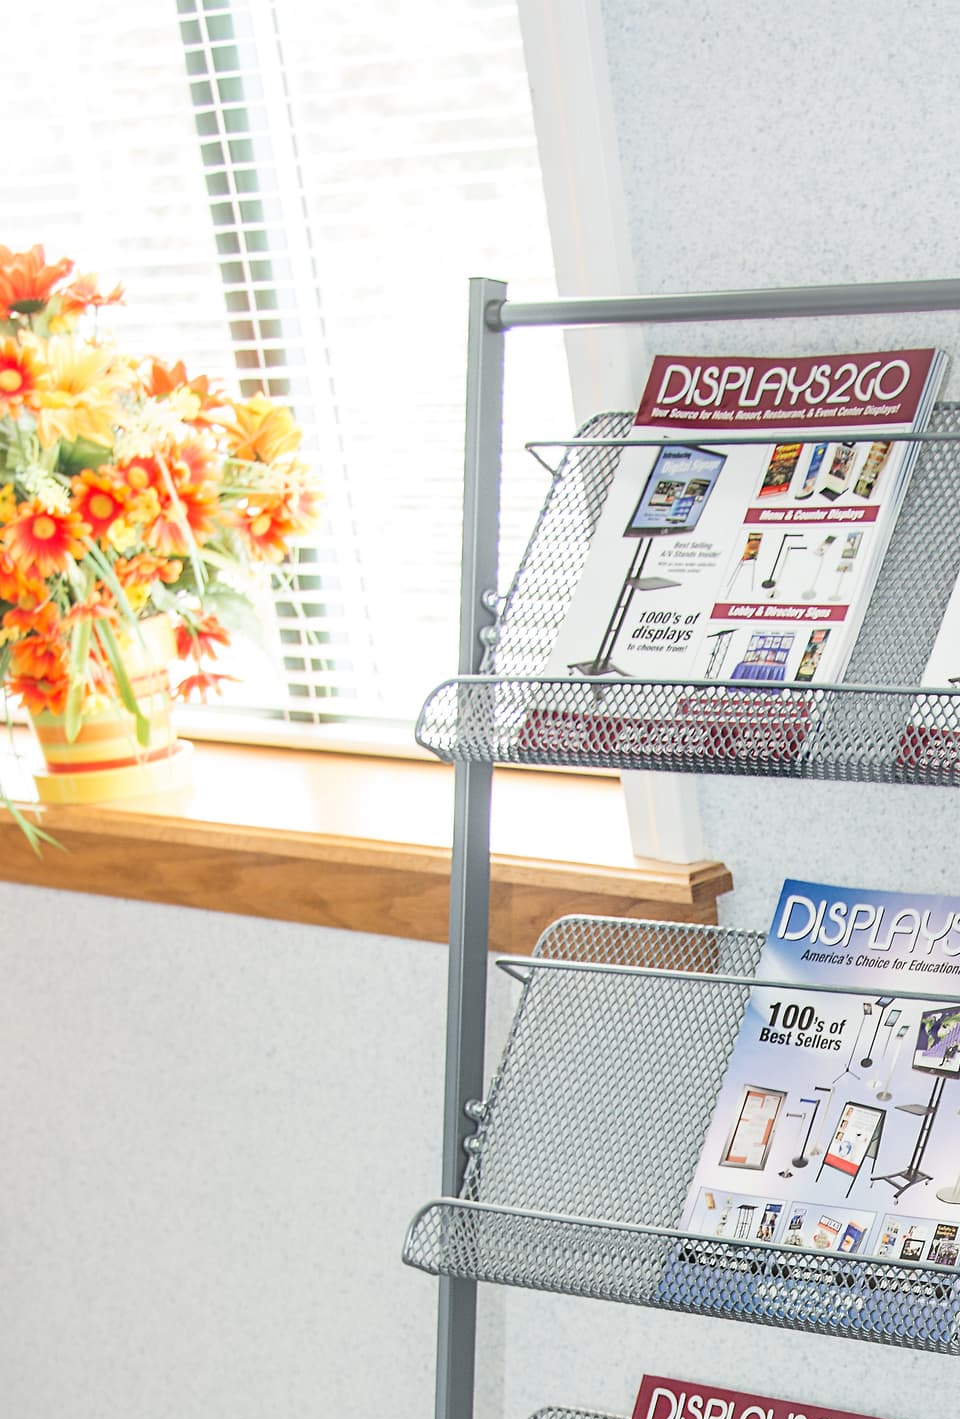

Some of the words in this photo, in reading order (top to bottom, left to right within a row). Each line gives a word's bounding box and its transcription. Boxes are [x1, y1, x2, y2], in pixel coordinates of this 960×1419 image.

[656, 359, 911, 407] DISPLAYS2GO
[638, 611, 680, 625] 1000's
[685, 612, 701, 625] of
[631, 626, 693, 644] displays
[636, 644, 665, 652] choose
[666, 644, 688, 654] from!
[801, 950, 853, 967] America's
[855, 955, 890, 969] Choice
[891, 958, 906, 970] for
[769, 1001, 825, 1033] 100's
[829, 1018, 847, 1035] of
[759, 1027, 792, 1045] Best
[797, 1032, 842, 1051] Sellers
